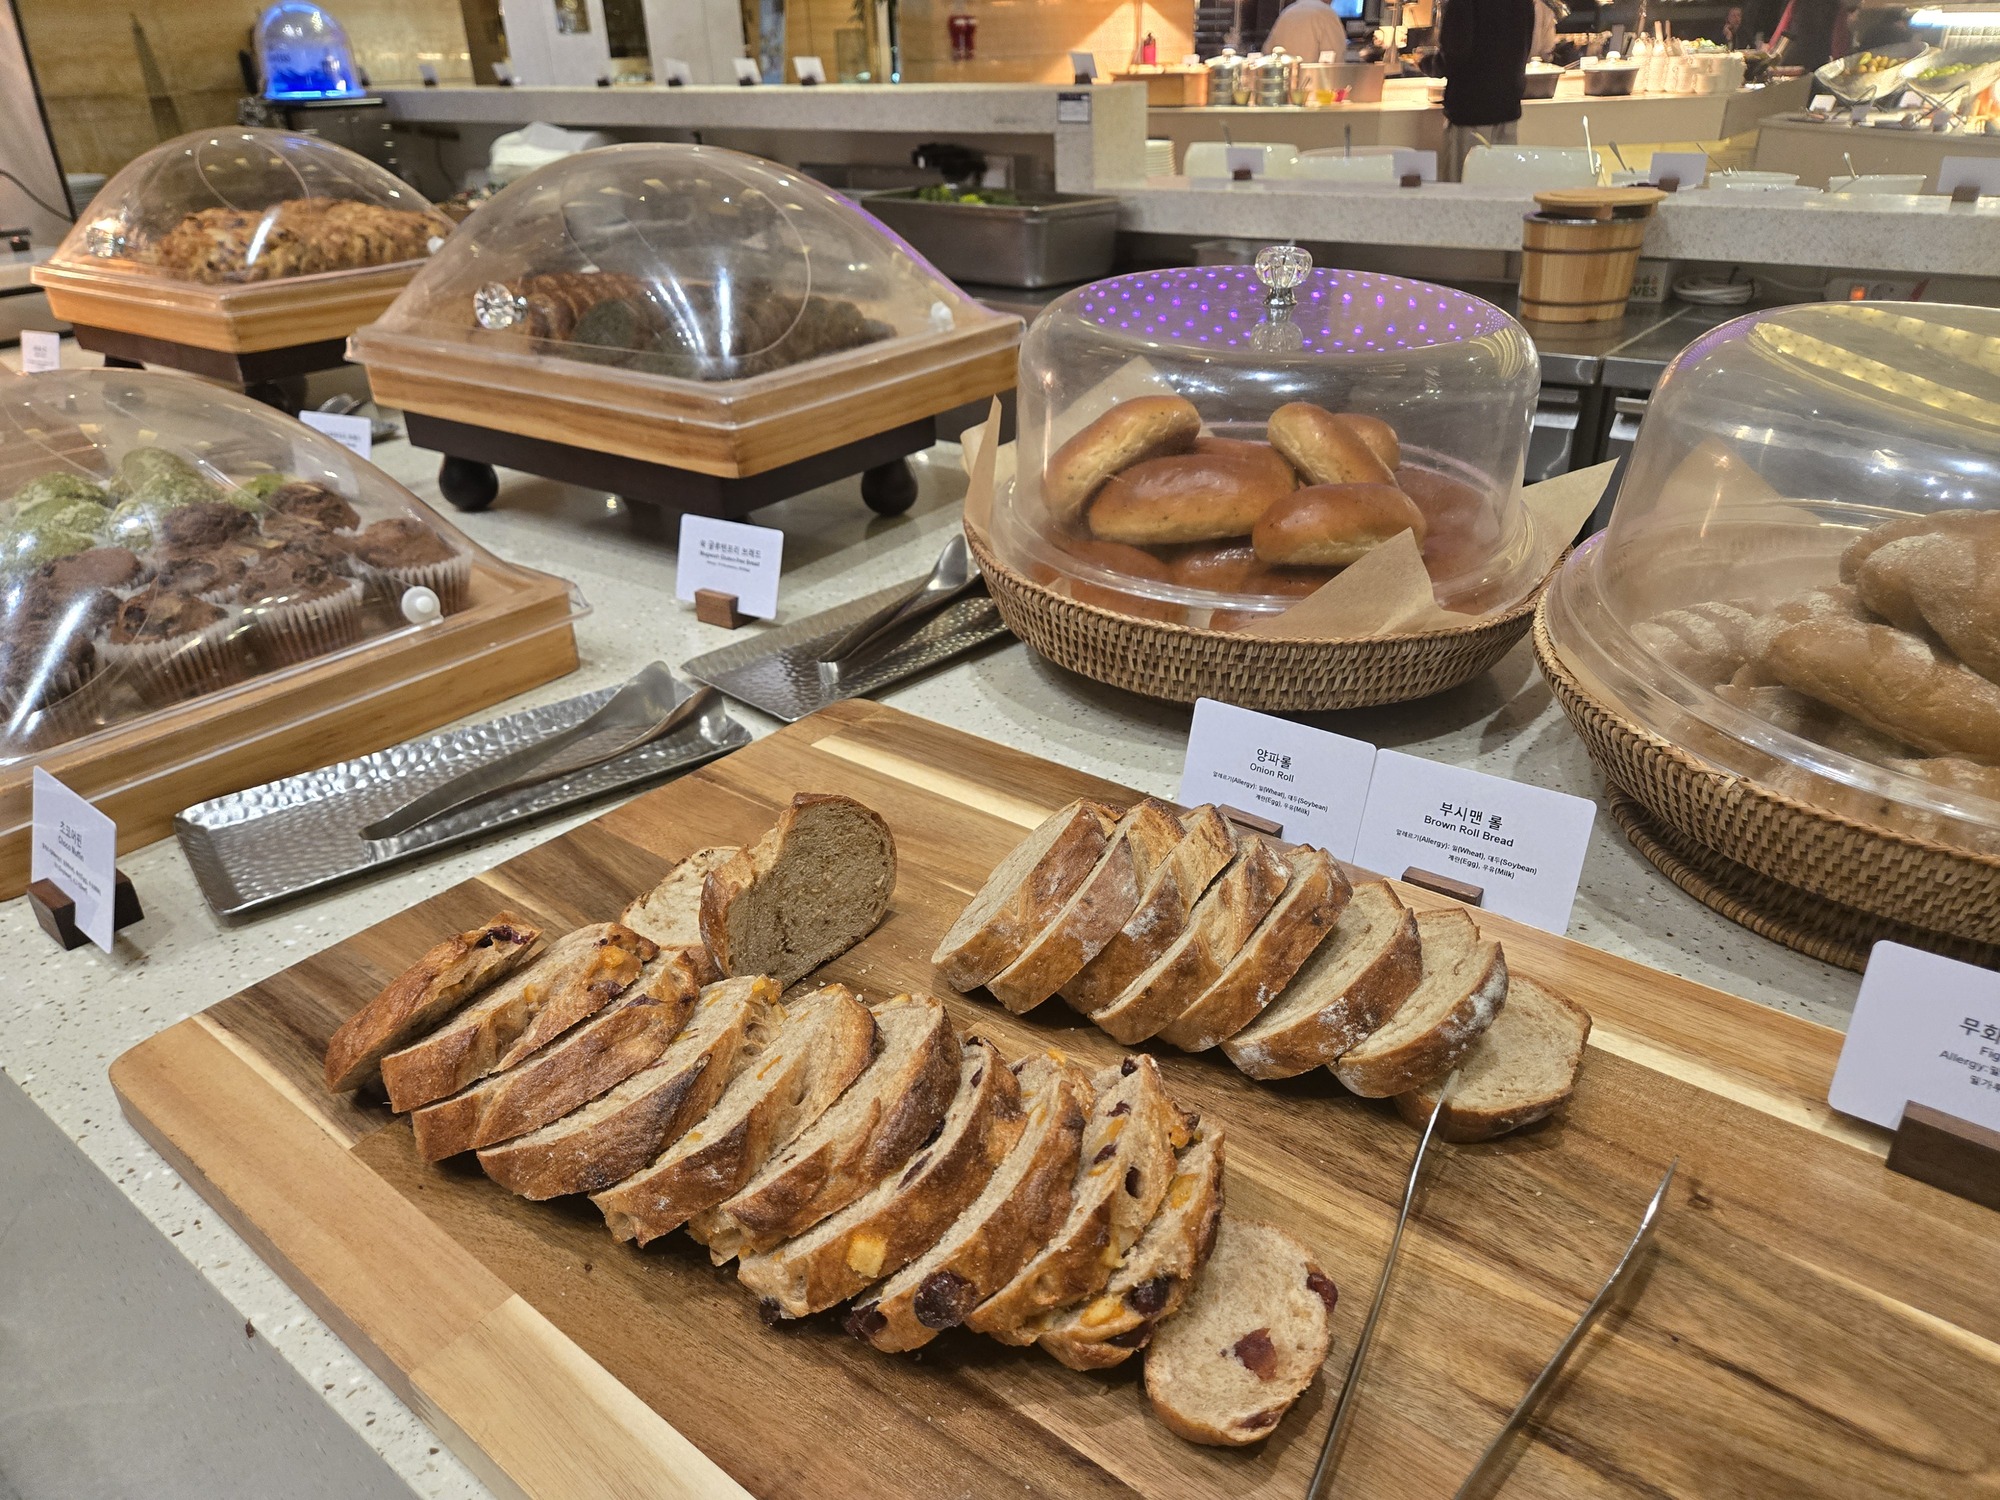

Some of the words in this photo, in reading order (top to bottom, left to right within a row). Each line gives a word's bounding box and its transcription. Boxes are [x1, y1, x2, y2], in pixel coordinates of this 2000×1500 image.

[1256, 748, 1292, 769] 양파롤
[1249, 762, 1275, 777] Onion
[1277, 770, 1295, 783] Roll
[1439, 802, 1484, 826] 부시맨
[1487, 814, 1503, 831] 롤
[1424, 815, 1457, 832] Brown
[1458, 824, 1480, 838] Roll
[1482, 831, 1515, 847] Bread
[1395, 828, 1451, 850] 알레르기(Allergy):
[1451, 844, 1487, 861] 밀(Wheat),
[1487, 855, 1538, 875] 대두(Soybean)
[1447, 854, 1481, 870] 계란(Egg),
[1482, 864, 1516, 880] 우유(Milk)
